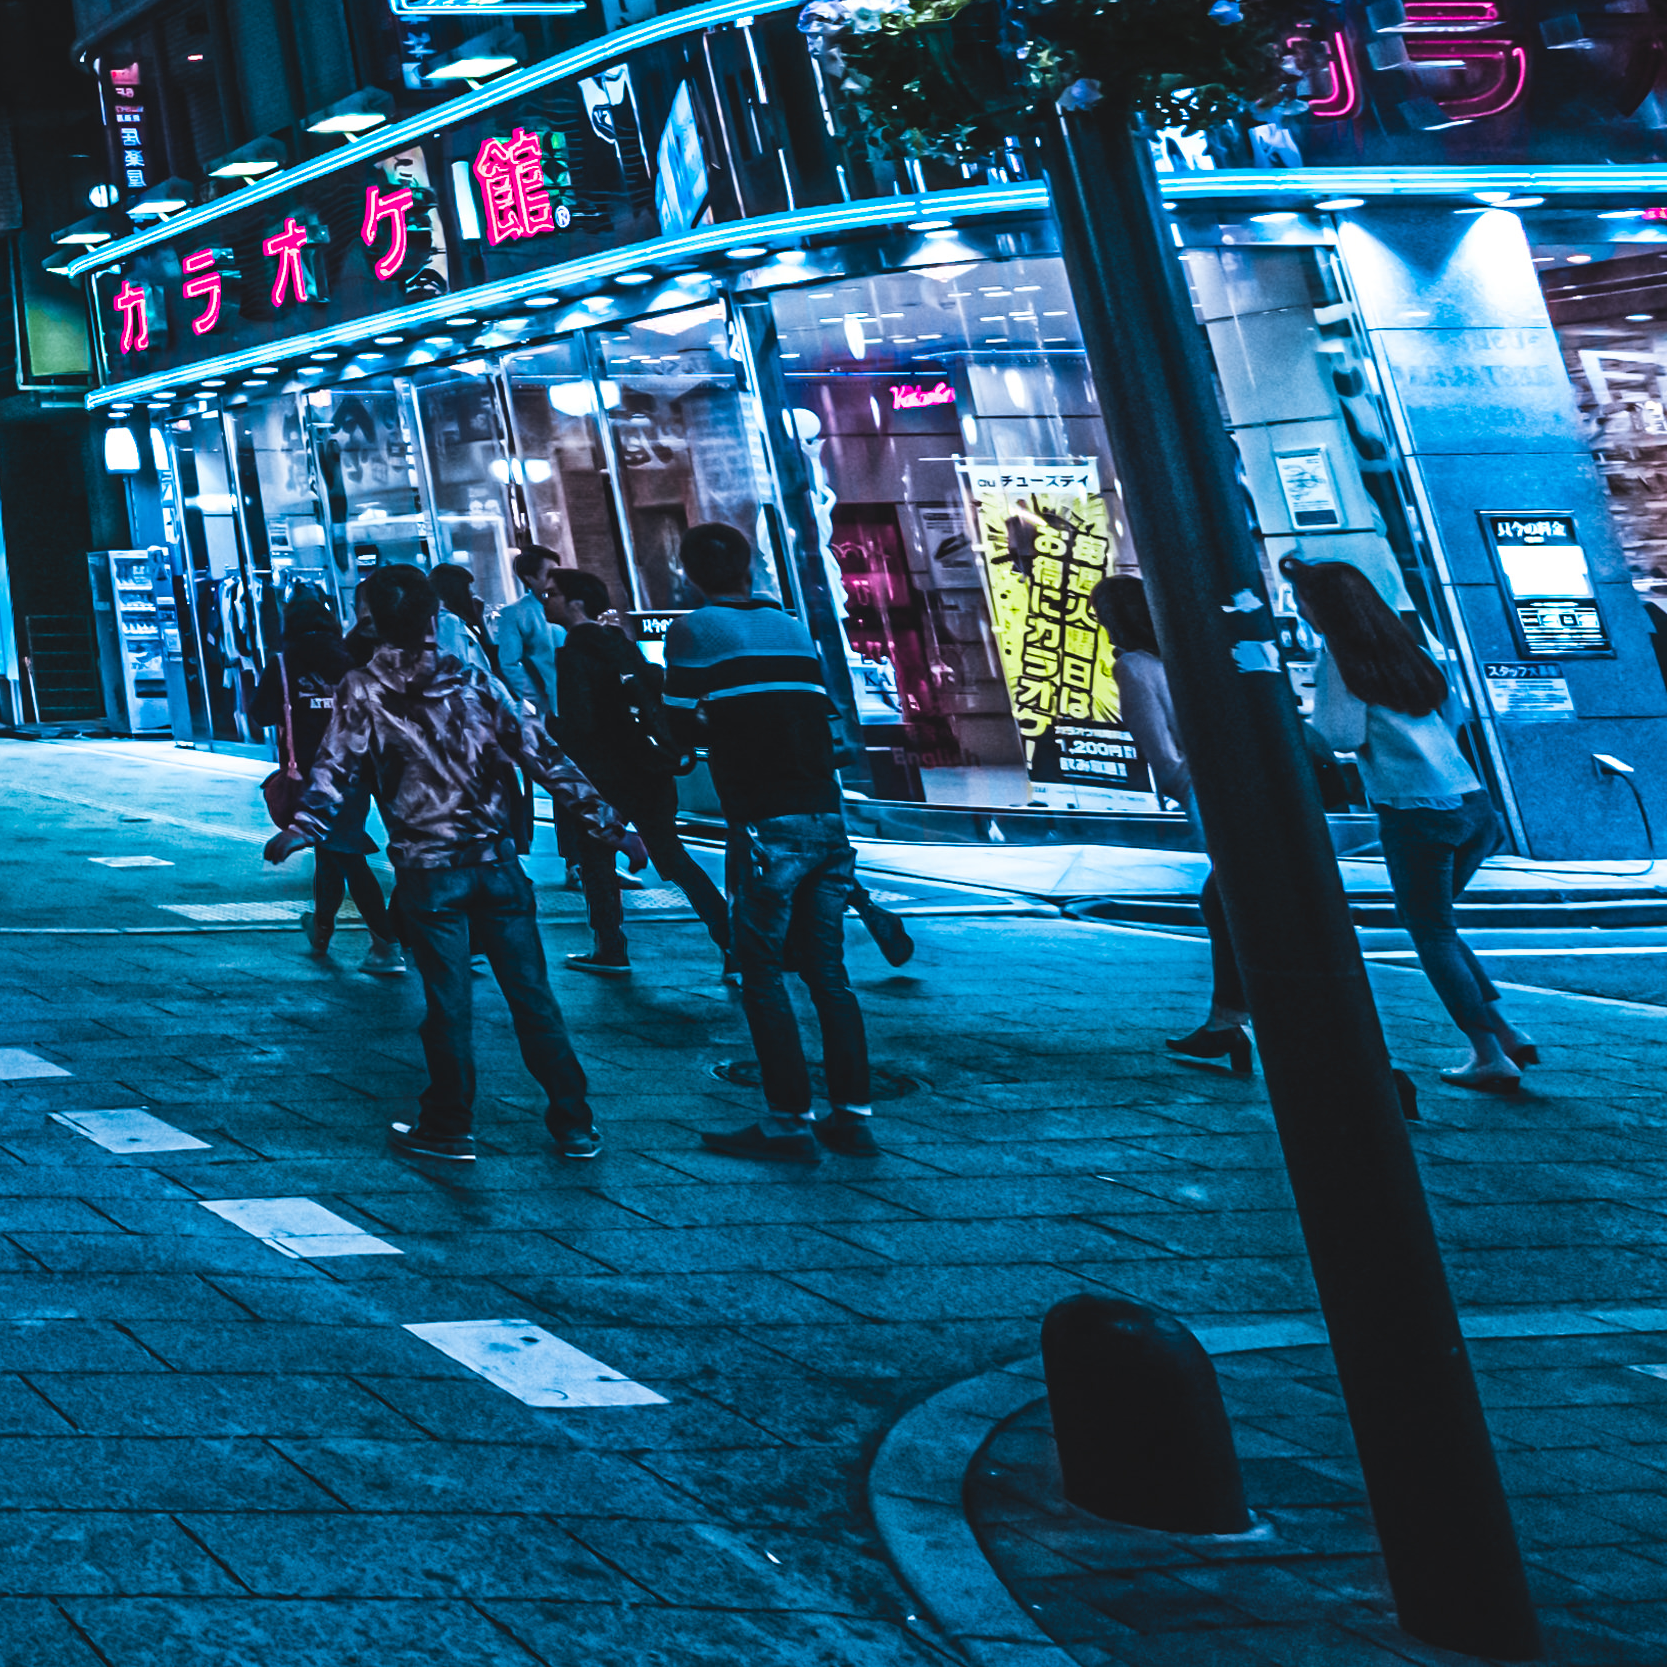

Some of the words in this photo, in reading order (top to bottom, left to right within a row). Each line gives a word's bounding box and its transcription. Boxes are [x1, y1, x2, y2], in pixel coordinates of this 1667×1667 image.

[113, 127, 555, 355] カラオケ館
